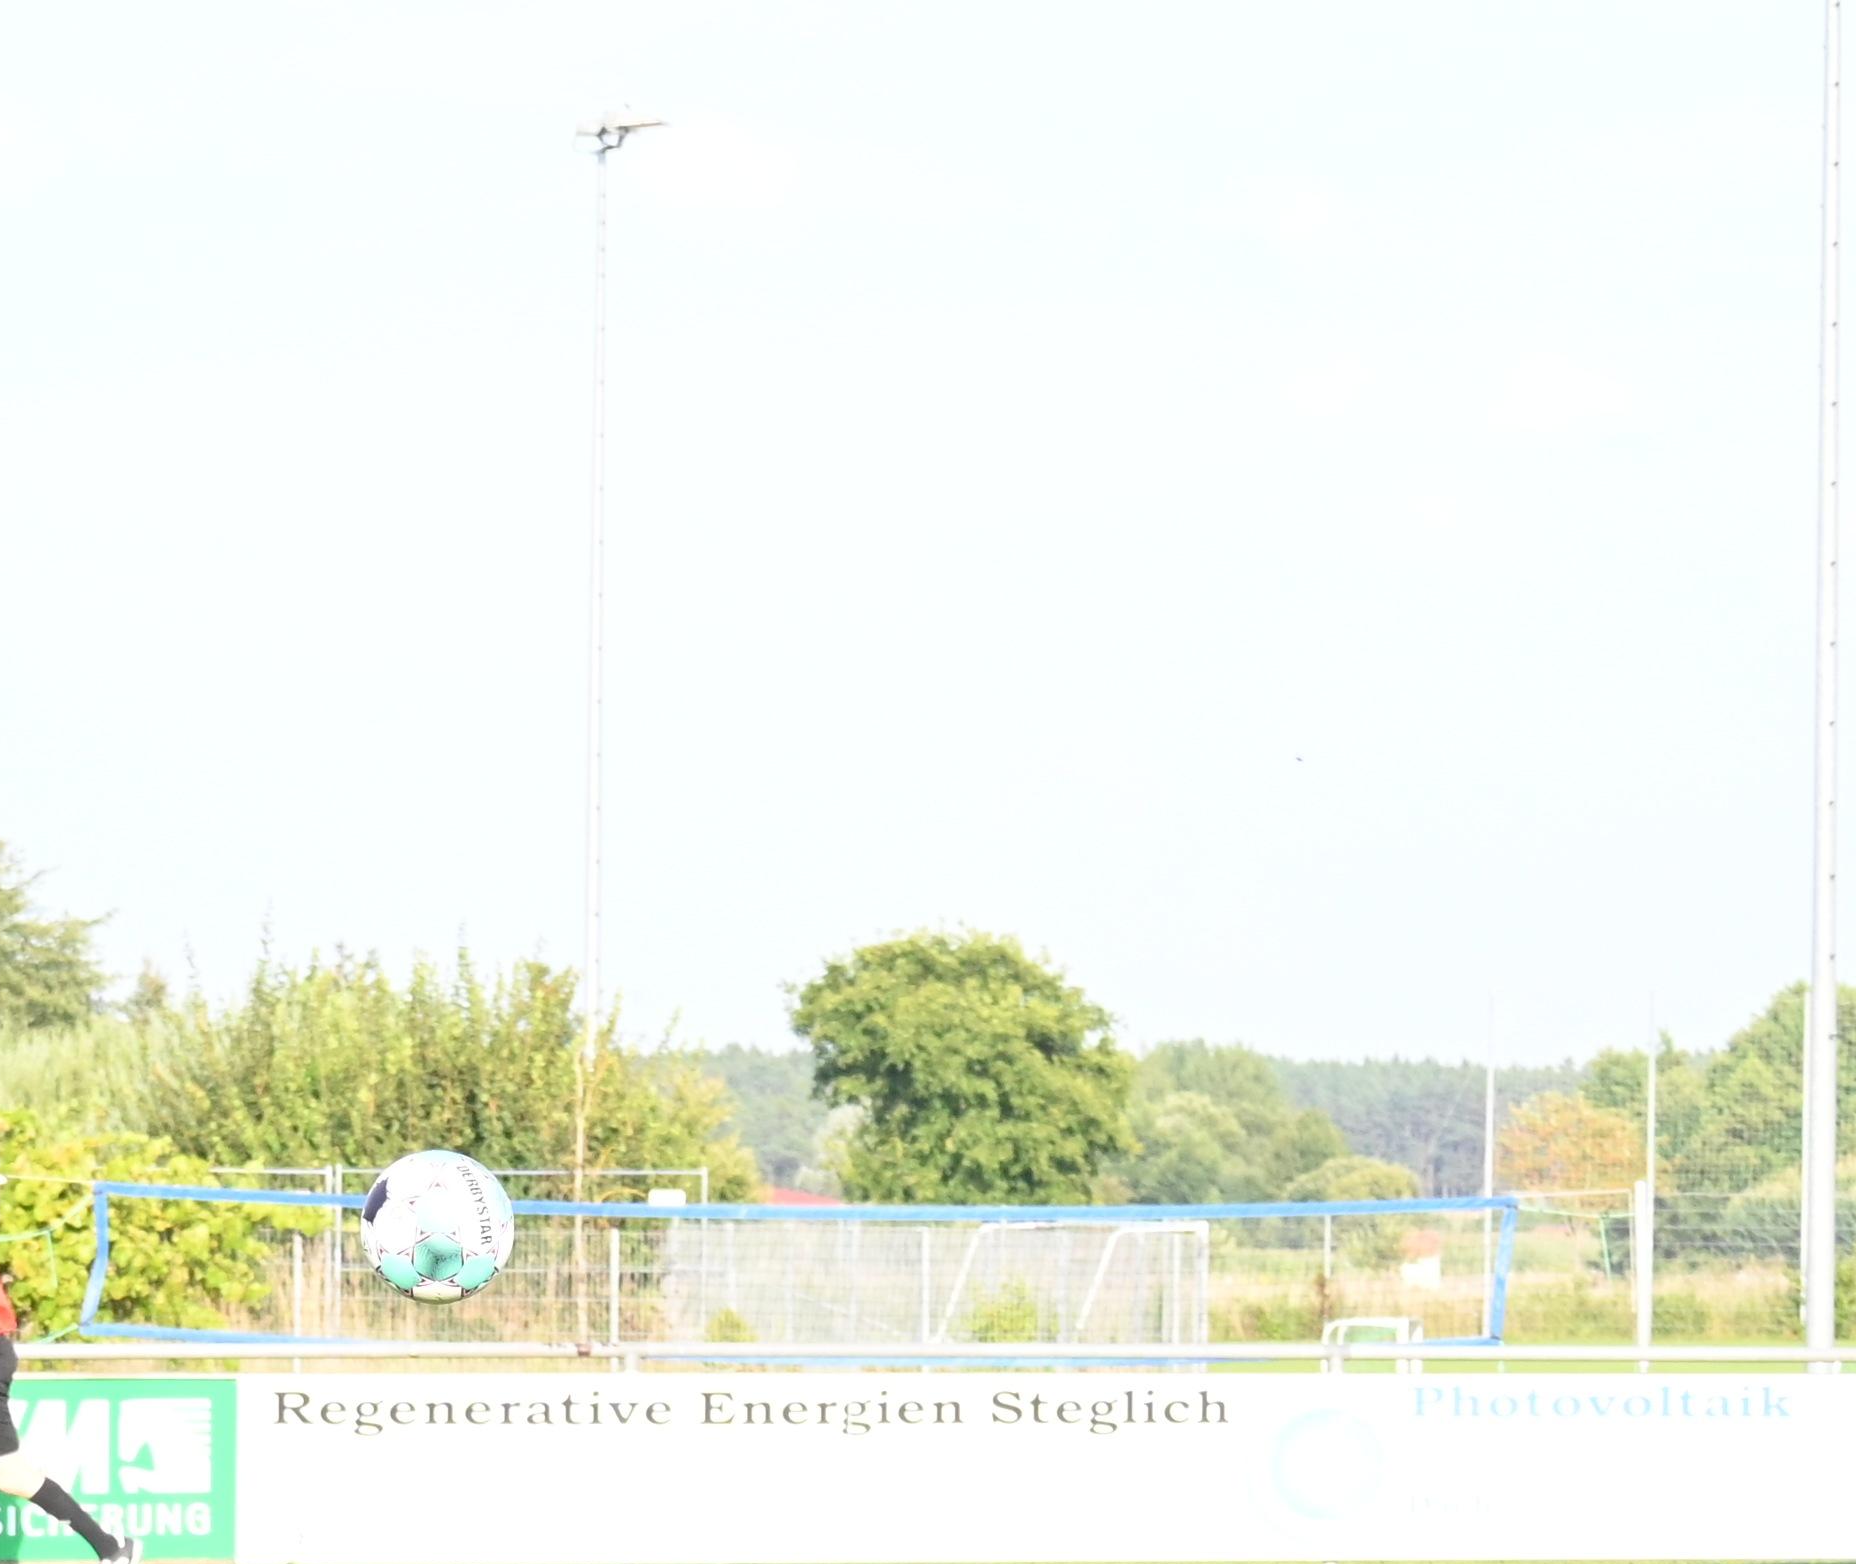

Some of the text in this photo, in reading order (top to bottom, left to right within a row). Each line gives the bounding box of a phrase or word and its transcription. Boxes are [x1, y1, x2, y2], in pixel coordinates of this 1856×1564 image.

[273, 1390, 1230, 1437] Regenerative Energien Steglich
[1411, 1385, 1794, 1418] Photovoltaik
